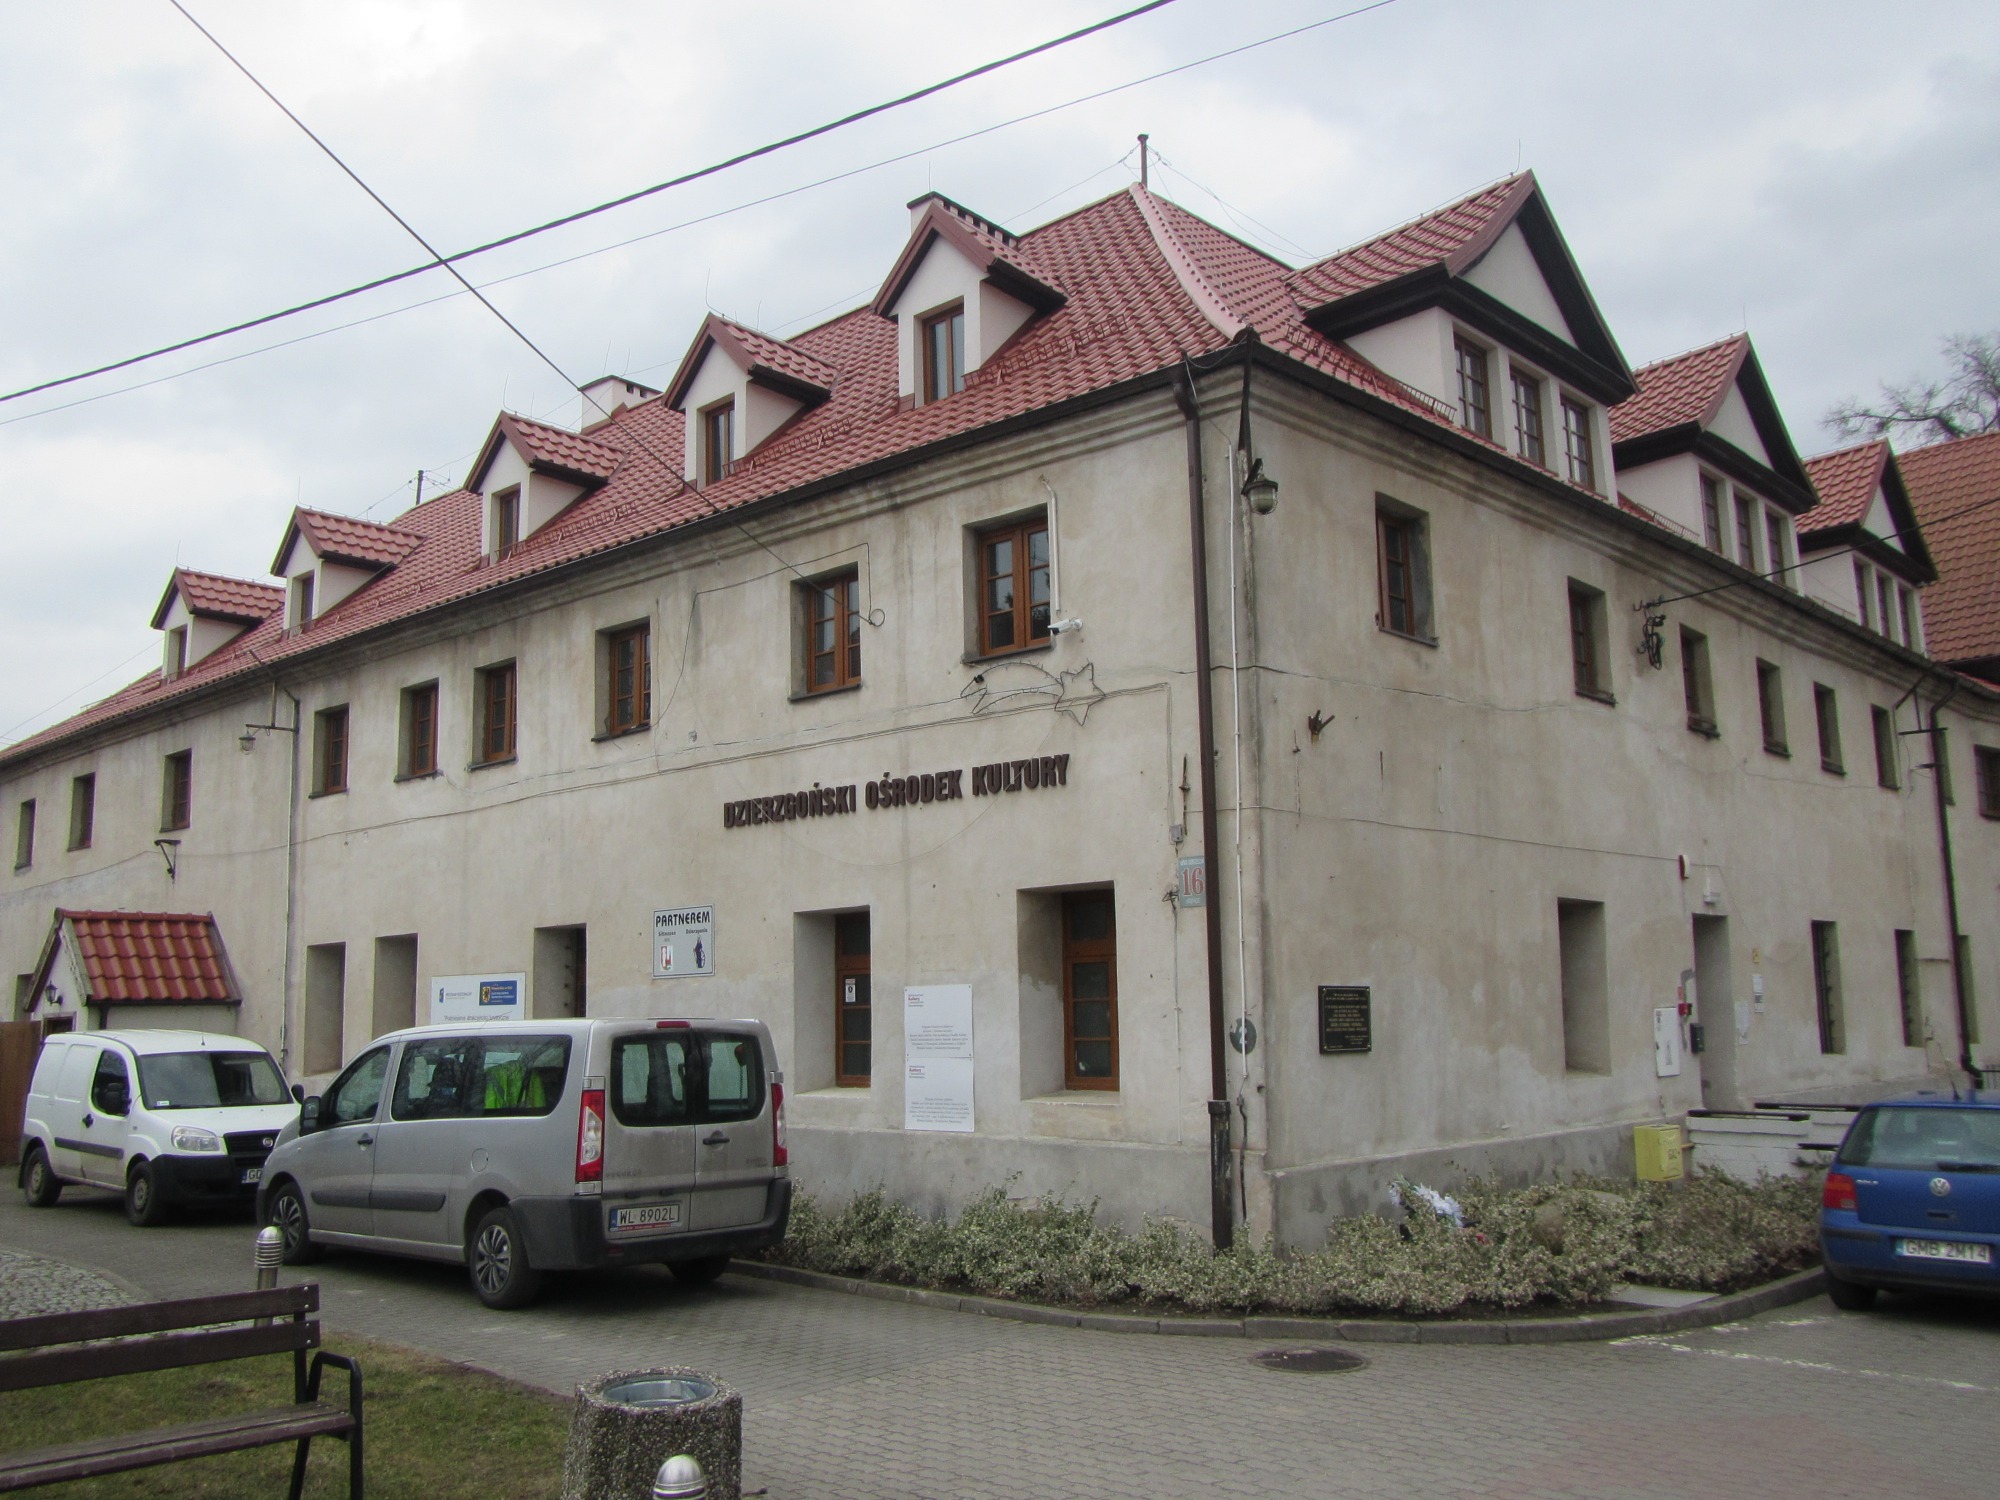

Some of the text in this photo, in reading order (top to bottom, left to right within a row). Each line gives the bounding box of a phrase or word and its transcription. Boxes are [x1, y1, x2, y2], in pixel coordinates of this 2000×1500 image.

[724, 754, 1070, 828] DZIERZGOŃSKI OŚRODEK KULTURY
[1182, 867, 1205, 896] 16
[656, 911, 710, 928] PARTNEREM
[620, 1207, 676, 1225] WL 8902L
